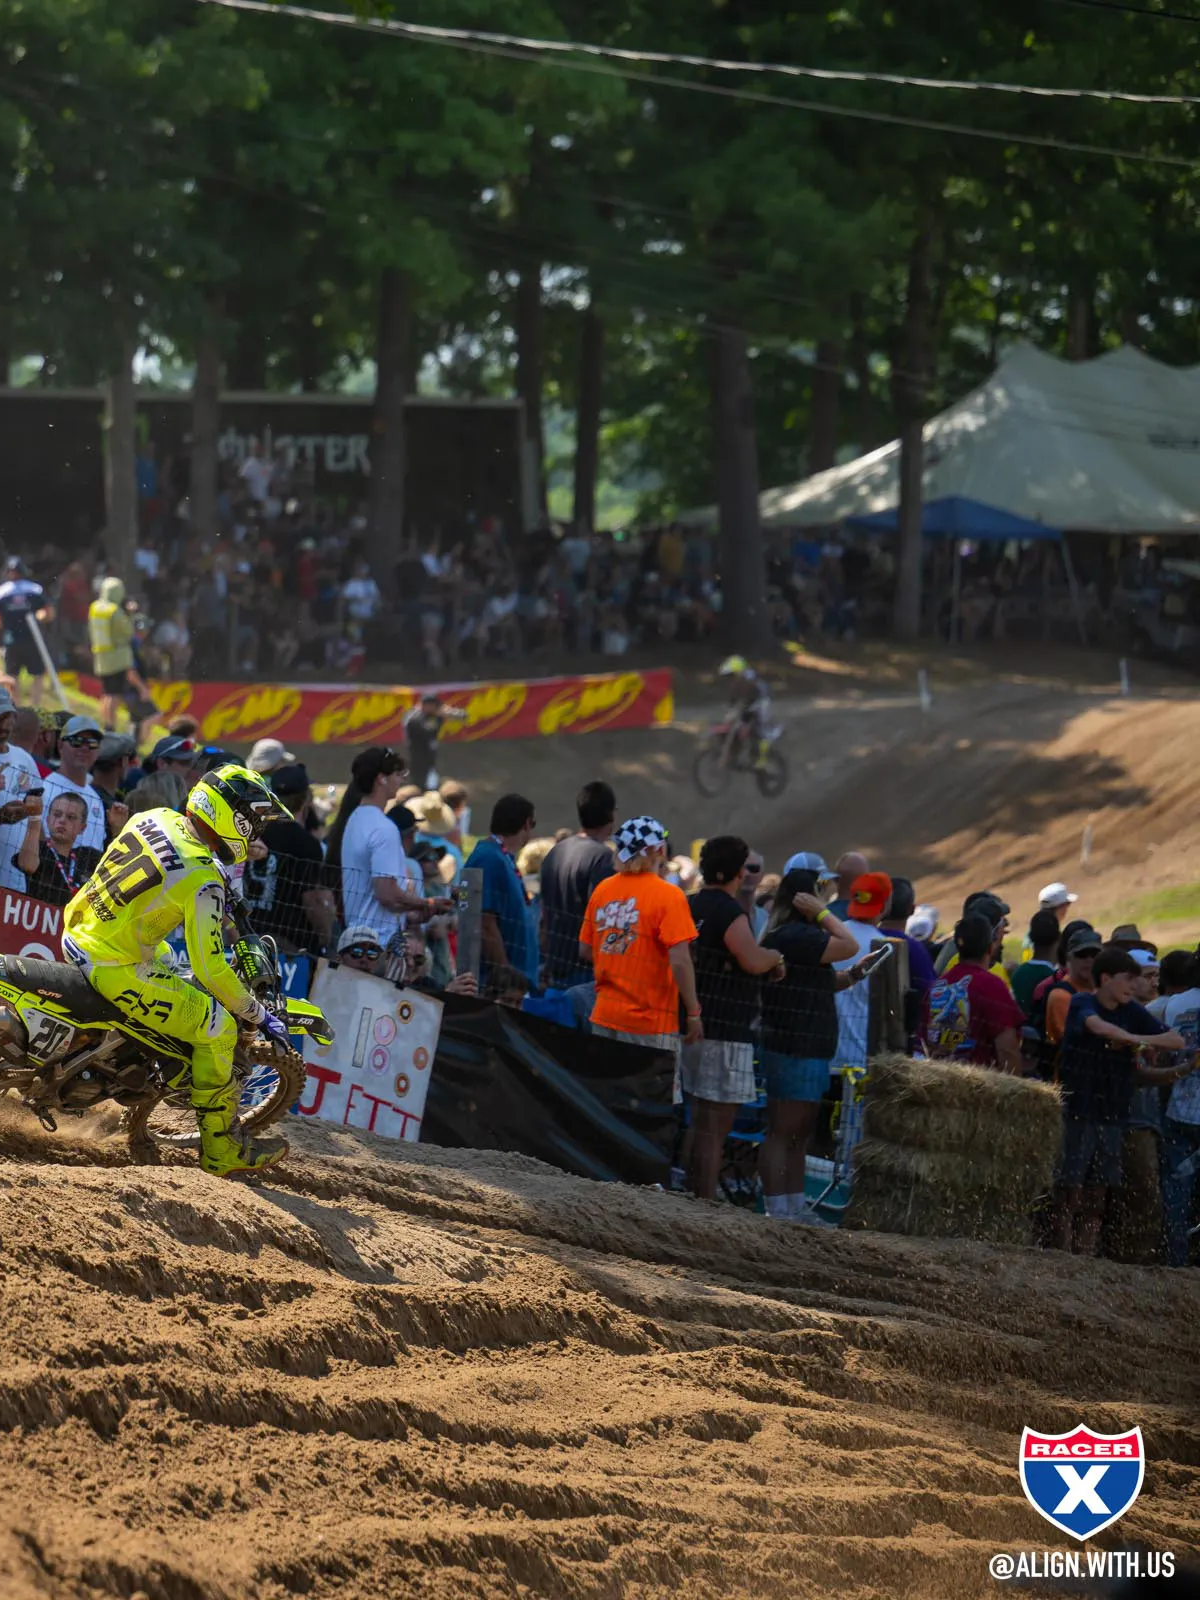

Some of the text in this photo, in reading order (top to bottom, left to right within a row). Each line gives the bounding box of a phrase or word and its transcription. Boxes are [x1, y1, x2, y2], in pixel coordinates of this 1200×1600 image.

[217, 425, 372, 477] ONSTER
[135, 818, 185, 872] SMITH
[233, 811, 250, 836] Arai
[97, 831, 164, 907] 20
[3, 894, 60, 937] HUN
[28, 1017, 71, 1060] 20
[297, 1062, 422, 1139] JETT
